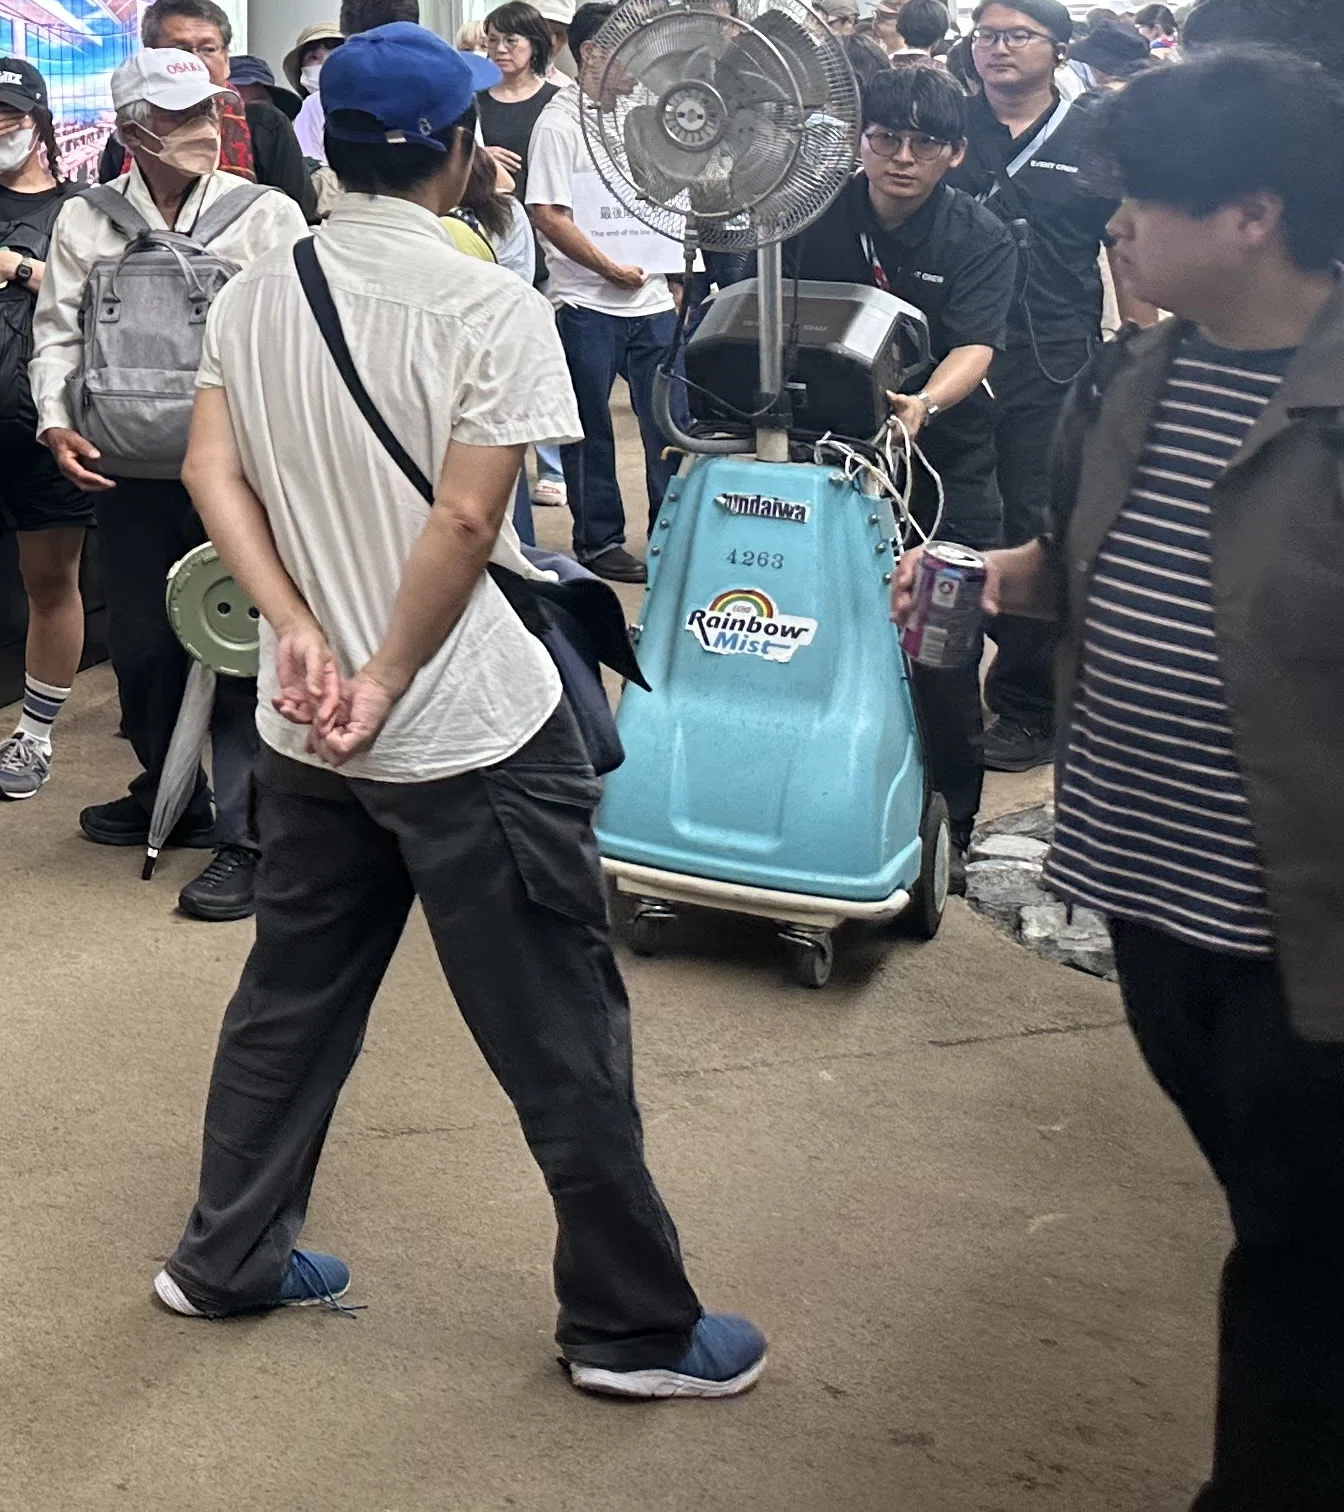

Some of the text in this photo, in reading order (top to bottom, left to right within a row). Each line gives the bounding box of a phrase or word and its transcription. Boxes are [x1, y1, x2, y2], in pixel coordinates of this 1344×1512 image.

[166, 61, 204, 74] OSAKA
[726, 549, 784, 569] 4263
[687, 609, 810, 646] Rainbow
[713, 631, 791, 655] Mist
